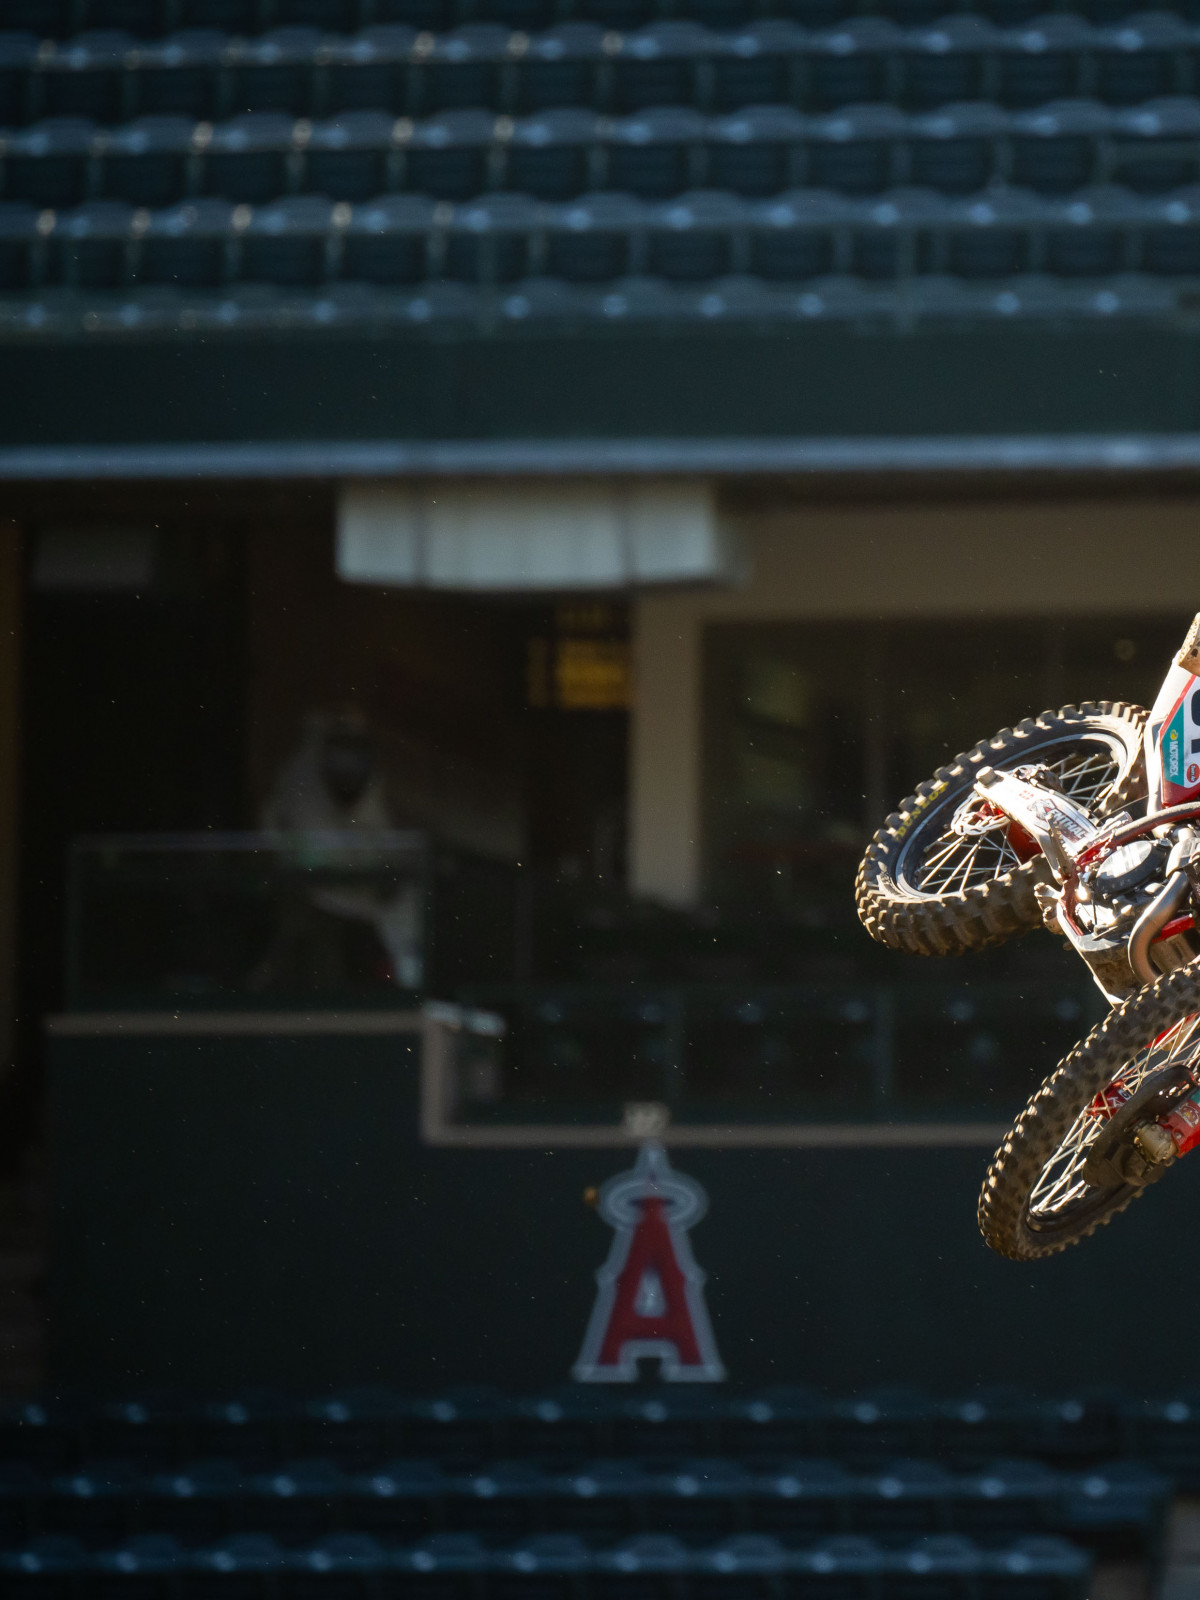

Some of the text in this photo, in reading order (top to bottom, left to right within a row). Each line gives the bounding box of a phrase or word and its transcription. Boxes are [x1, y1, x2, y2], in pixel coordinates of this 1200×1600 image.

[1169, 741, 1179, 777] MOTOREX
[895, 781, 949, 842] DUNLOP
[1047, 807, 1088, 839] ENTHAL
